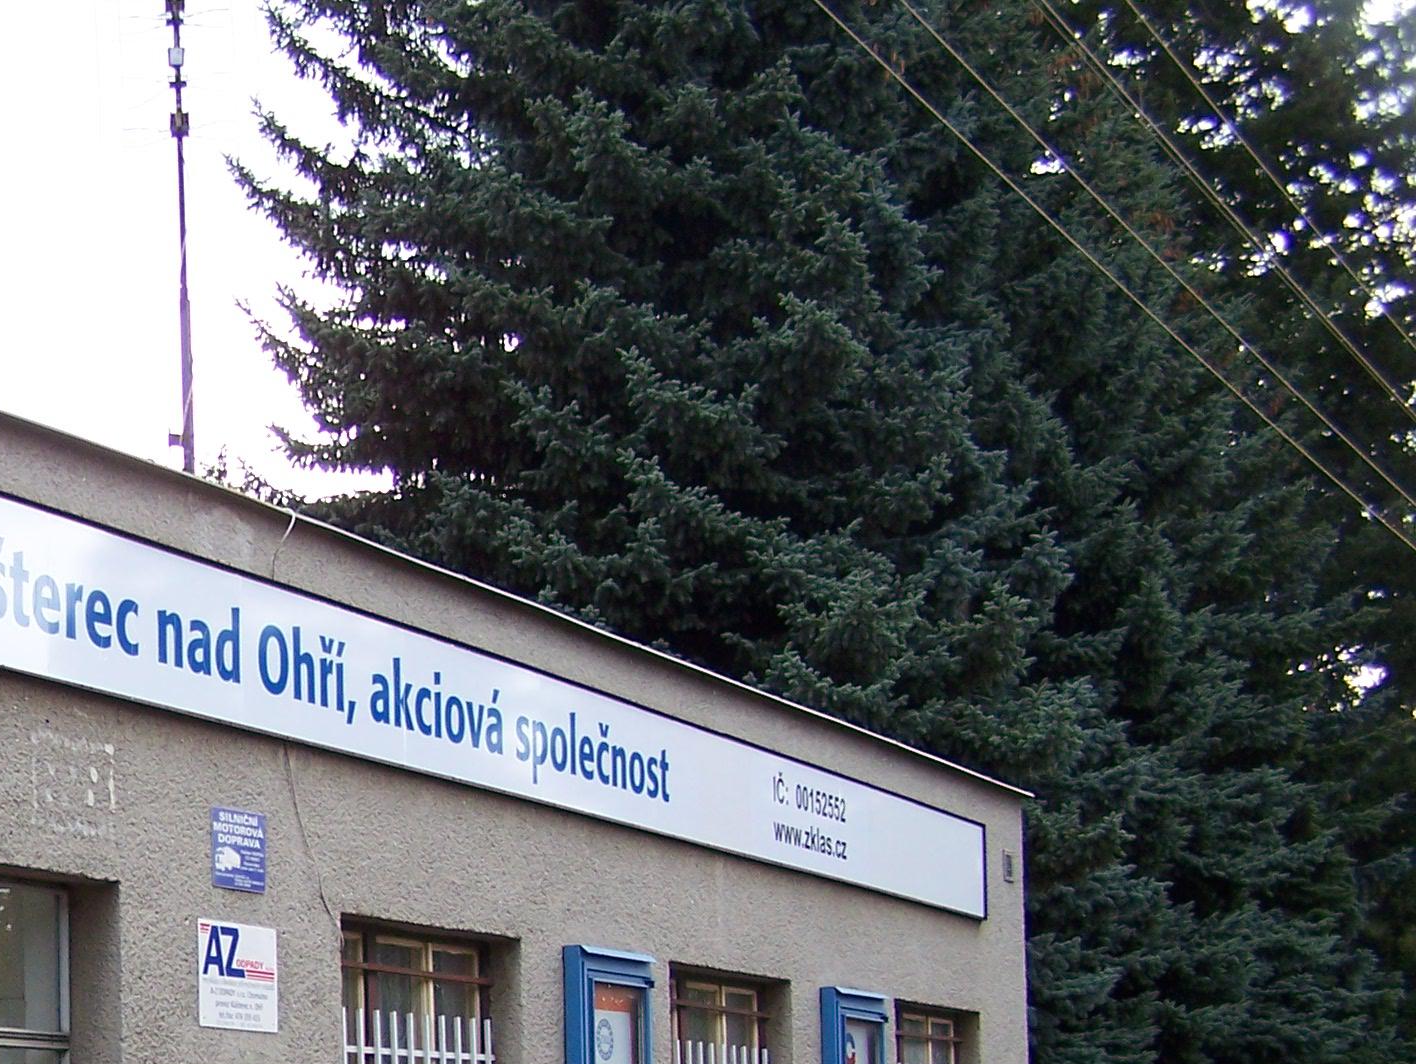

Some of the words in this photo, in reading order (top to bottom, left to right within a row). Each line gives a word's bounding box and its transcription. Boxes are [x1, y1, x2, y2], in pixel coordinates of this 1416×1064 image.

[157, 605, 242, 685] nad
[257, 625, 357, 727] Ohří,
[369, 657, 504, 756] akciová
[515, 712, 672, 805] společnost
[796, 784, 846, 823] 00152552
[213, 821, 264, 839] MOTOROVÁ
[218, 833, 261, 849] DOPRAVA
[773, 821, 847, 860] www.zklas.cz
[202, 925, 246, 978] AZ
